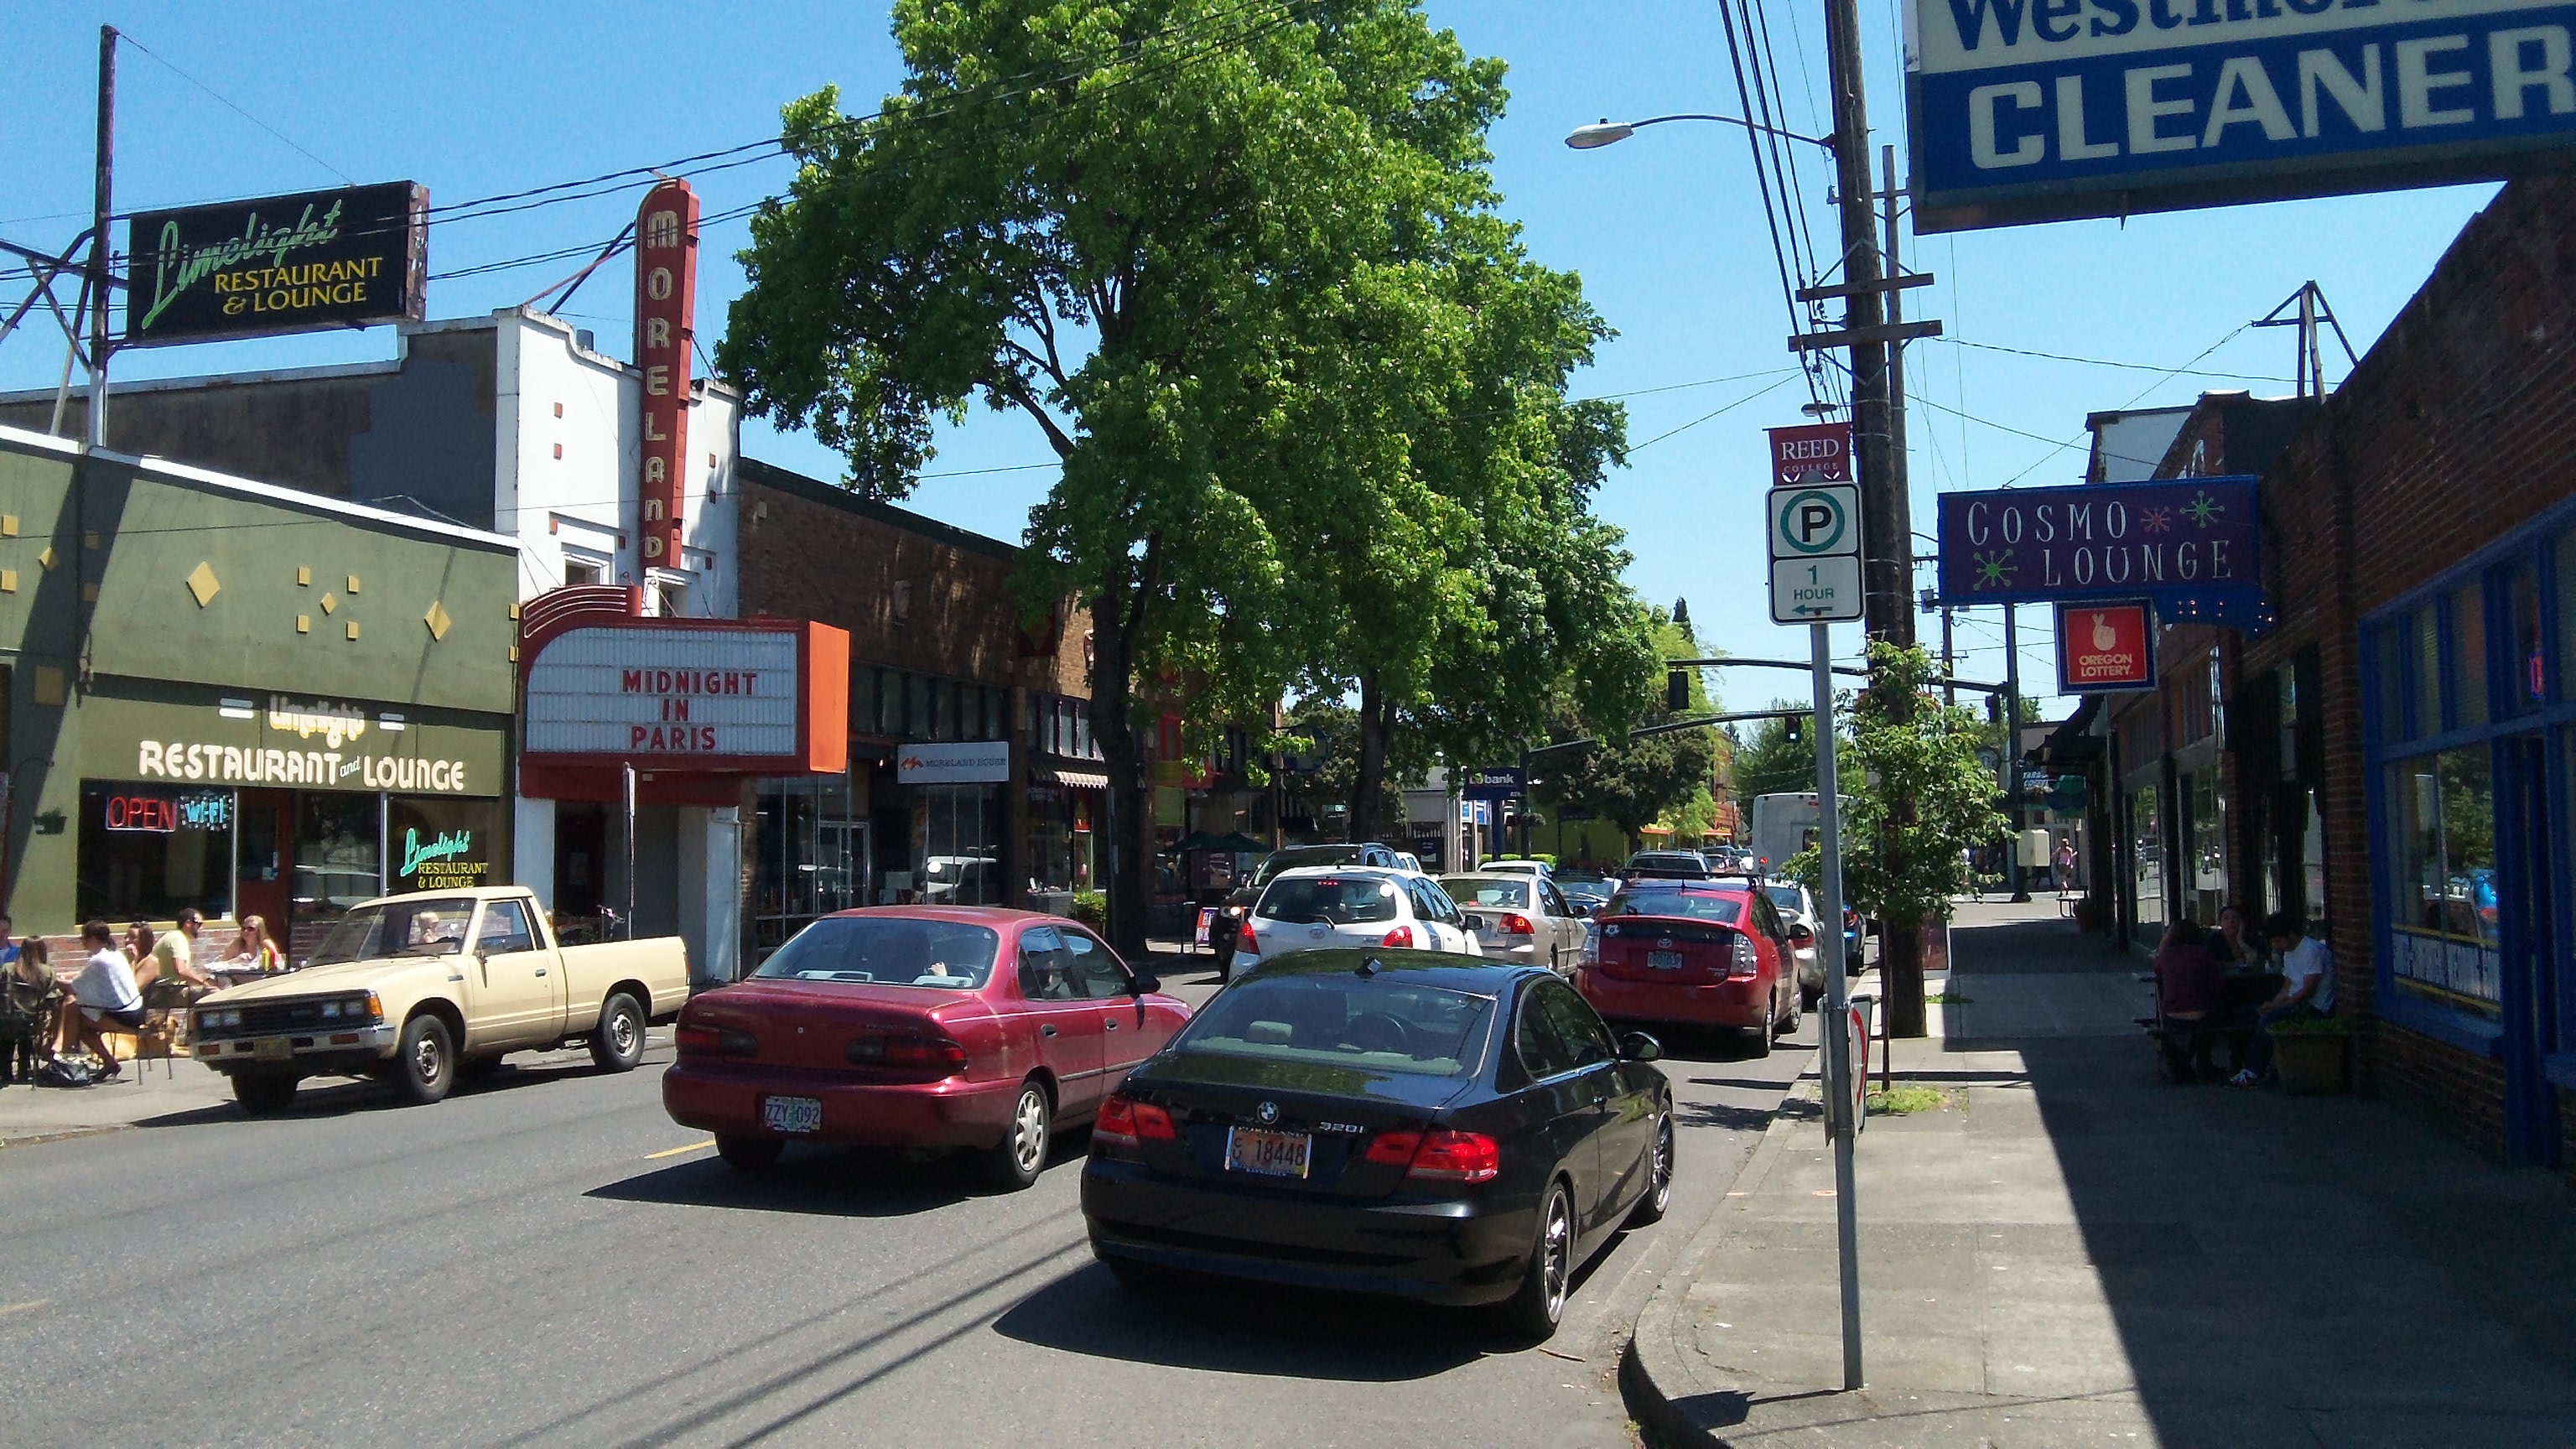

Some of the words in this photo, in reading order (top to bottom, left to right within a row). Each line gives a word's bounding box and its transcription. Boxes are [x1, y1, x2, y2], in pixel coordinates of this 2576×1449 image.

[141, 199, 342, 330] Limelight
[215, 257, 383, 293] RESTAURANT
[222, 296, 247, 314] &
[254, 282, 367, 312] LOUNGE
[644, 210, 678, 559] MORELAND
[1780, 439, 1840, 461] REED
[1784, 462, 1838, 474] COLLEGE
[1800, 505, 1831, 543] P
[1967, 501, 2127, 547] COSMO
[1807, 564, 1818, 585] 1
[2044, 540, 2231, 587] LOUNGE
[1794, 588, 1834, 600] HOUR
[2079, 654, 2132, 666] OREGON
[2080, 665, 2131, 678] LOTTERY
[622, 670, 757, 695] MIDNIGHT
[269, 694, 365, 749] Limelight
[662, 699, 688, 721] IN
[631, 725, 715, 750] PARIS
[138, 740, 342, 786] RESTAURANT
[340, 756, 361, 778] and
[364, 756, 464, 791] LOUNGE
[926, 758, 975, 768] MORELAND
[108, 796, 175, 830] OPEN
[418, 862, 488, 875] RESTAURANT
[418, 876, 426, 888] &
[428, 876, 475, 888] LOUNGE
[1257, 1139, 1306, 1166] 18448
